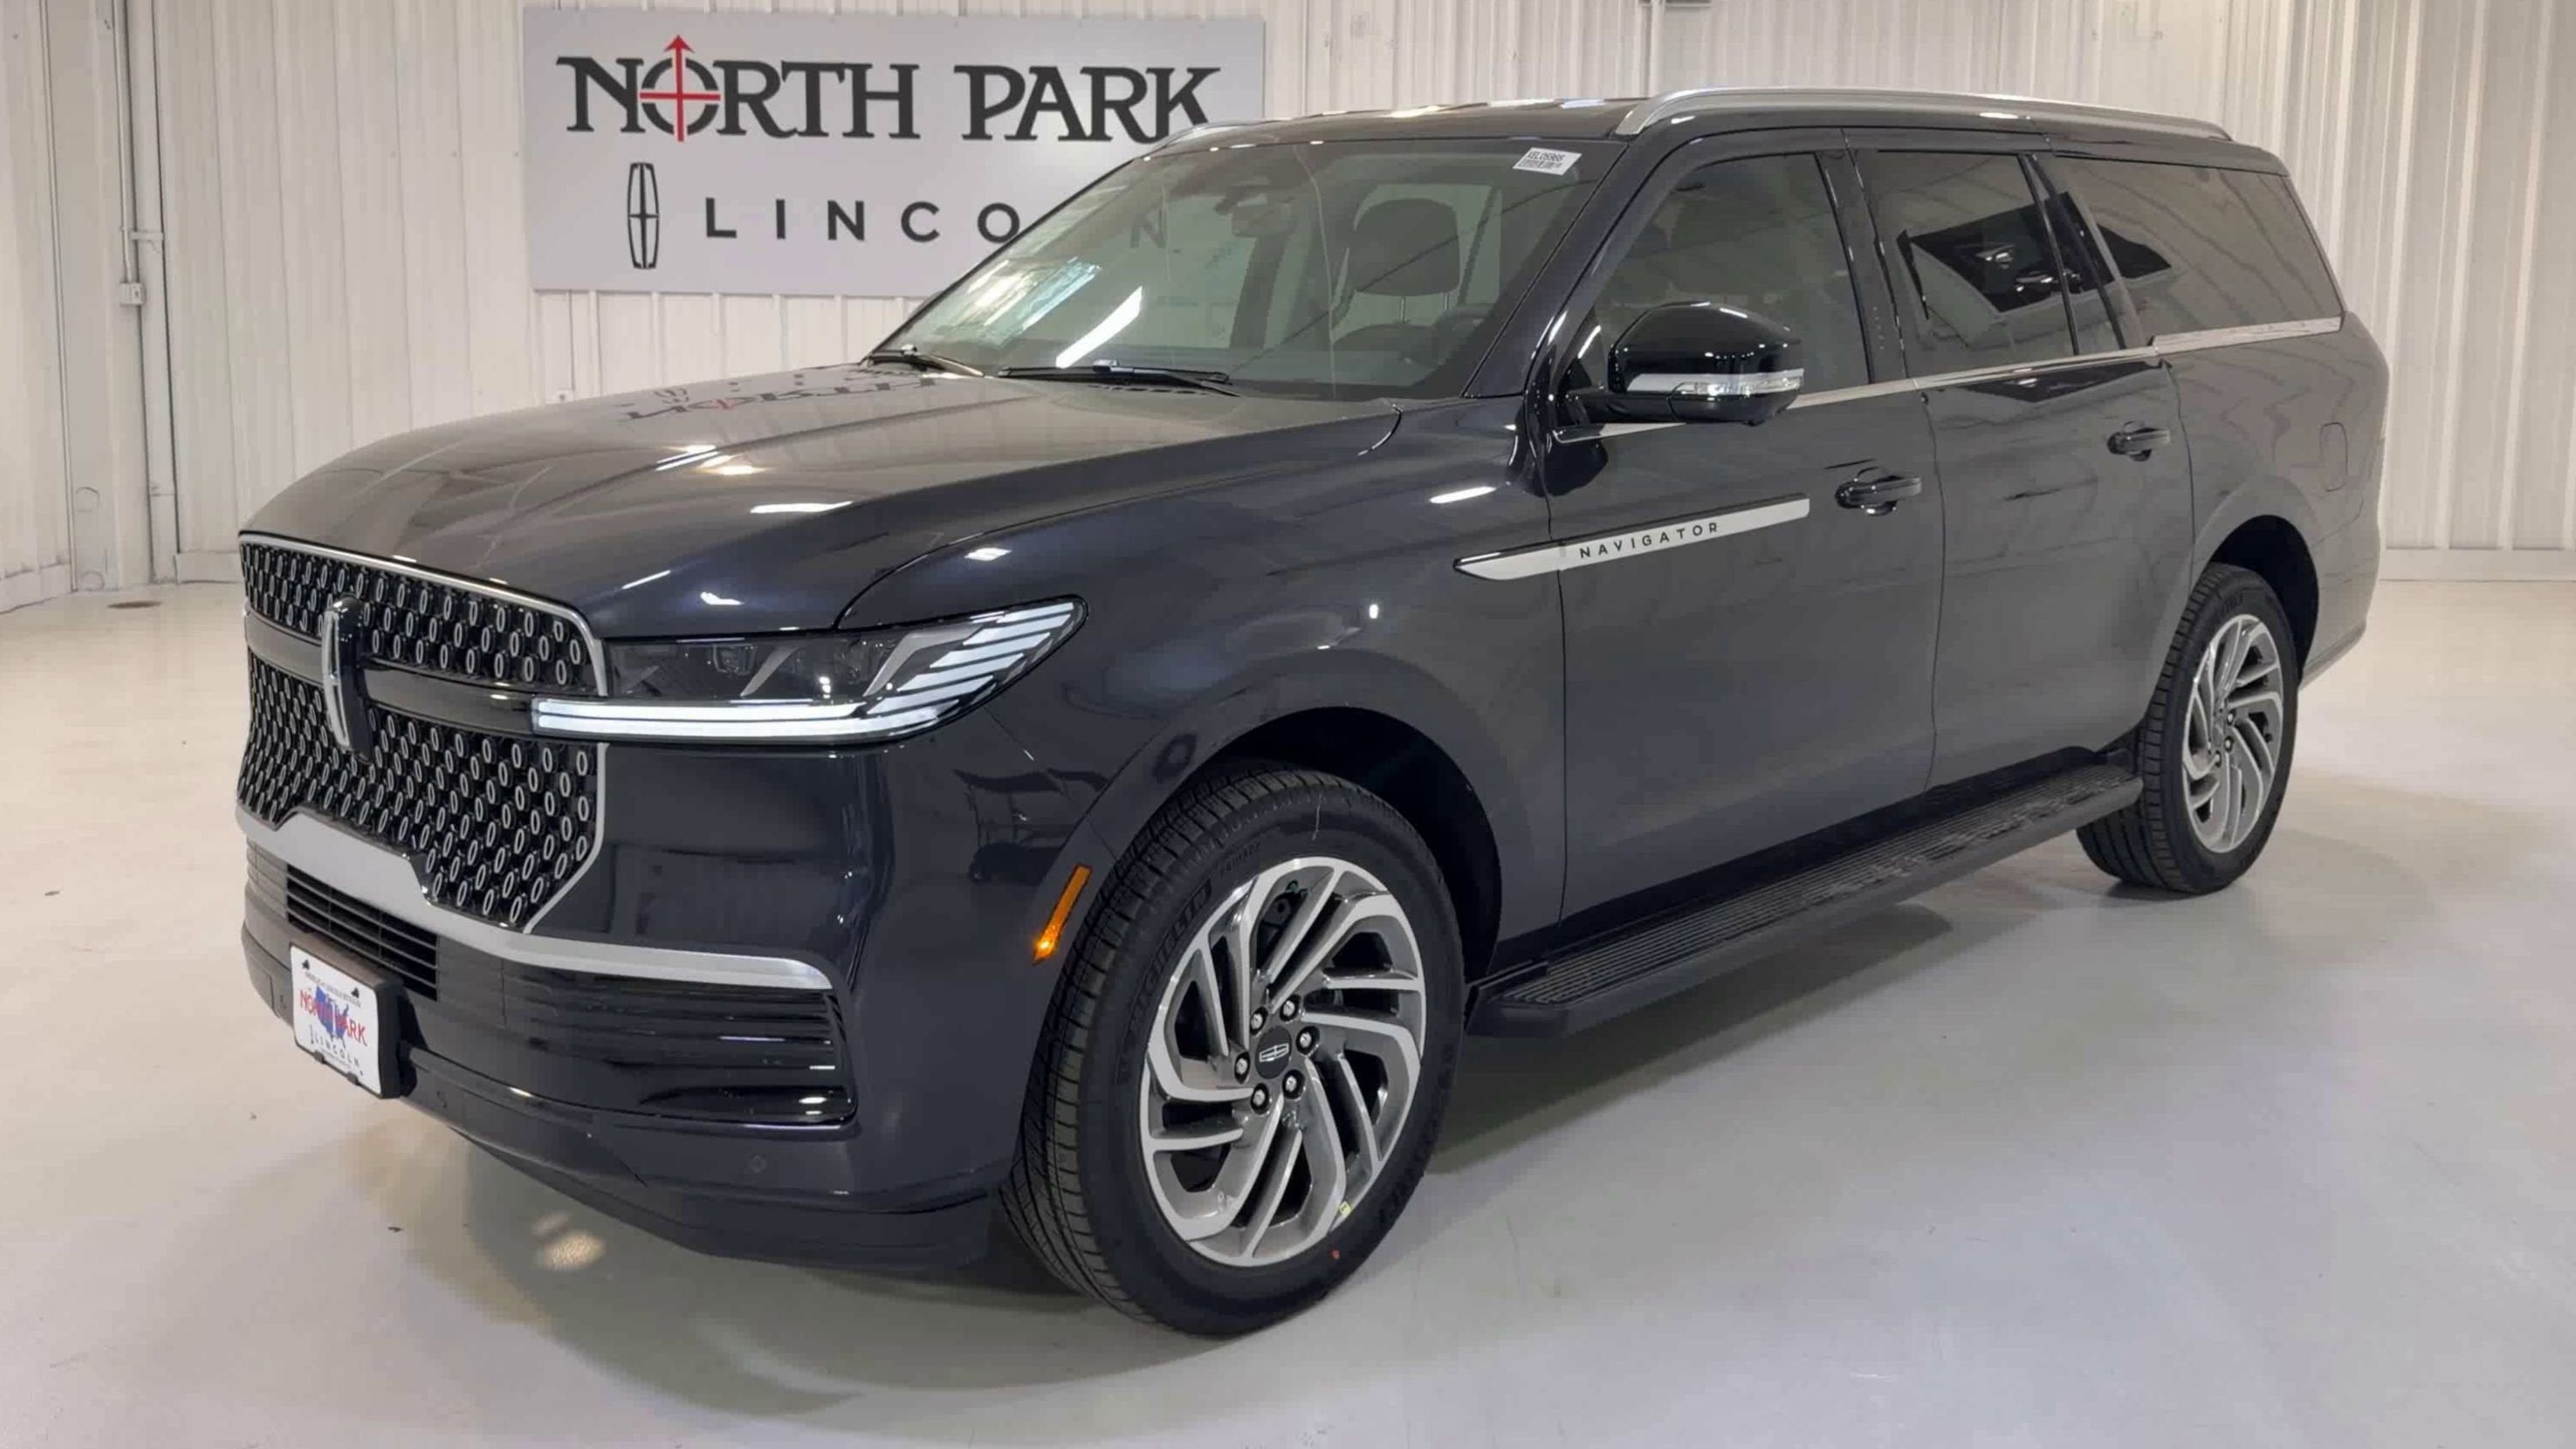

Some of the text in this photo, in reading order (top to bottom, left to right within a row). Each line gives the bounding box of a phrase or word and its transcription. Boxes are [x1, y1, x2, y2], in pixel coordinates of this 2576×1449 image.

[556, 56, 1221, 144] NORTH PARK
[704, 197, 1167, 249] LINCON
[1579, 520, 1718, 559] NAVIGATOR
